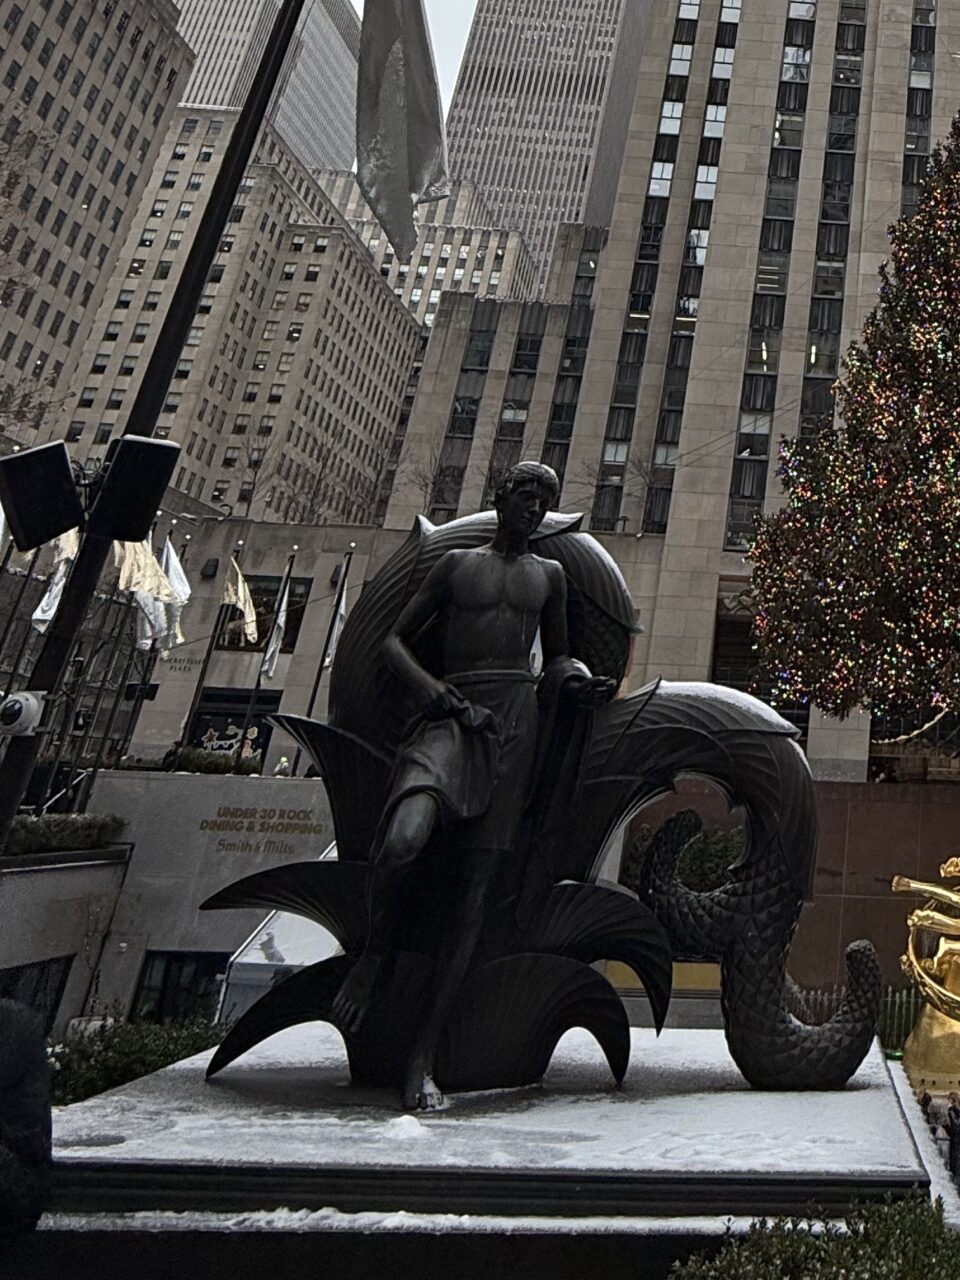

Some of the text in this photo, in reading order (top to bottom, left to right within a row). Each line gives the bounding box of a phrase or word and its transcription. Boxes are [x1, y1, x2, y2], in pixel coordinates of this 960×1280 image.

[217, 807, 313, 821] UNDER 30 ROCK
[199, 819, 323, 834] DINING & SHOPPING
[216, 838, 252, 853] Smith
[263, 840, 295, 854] Mills
